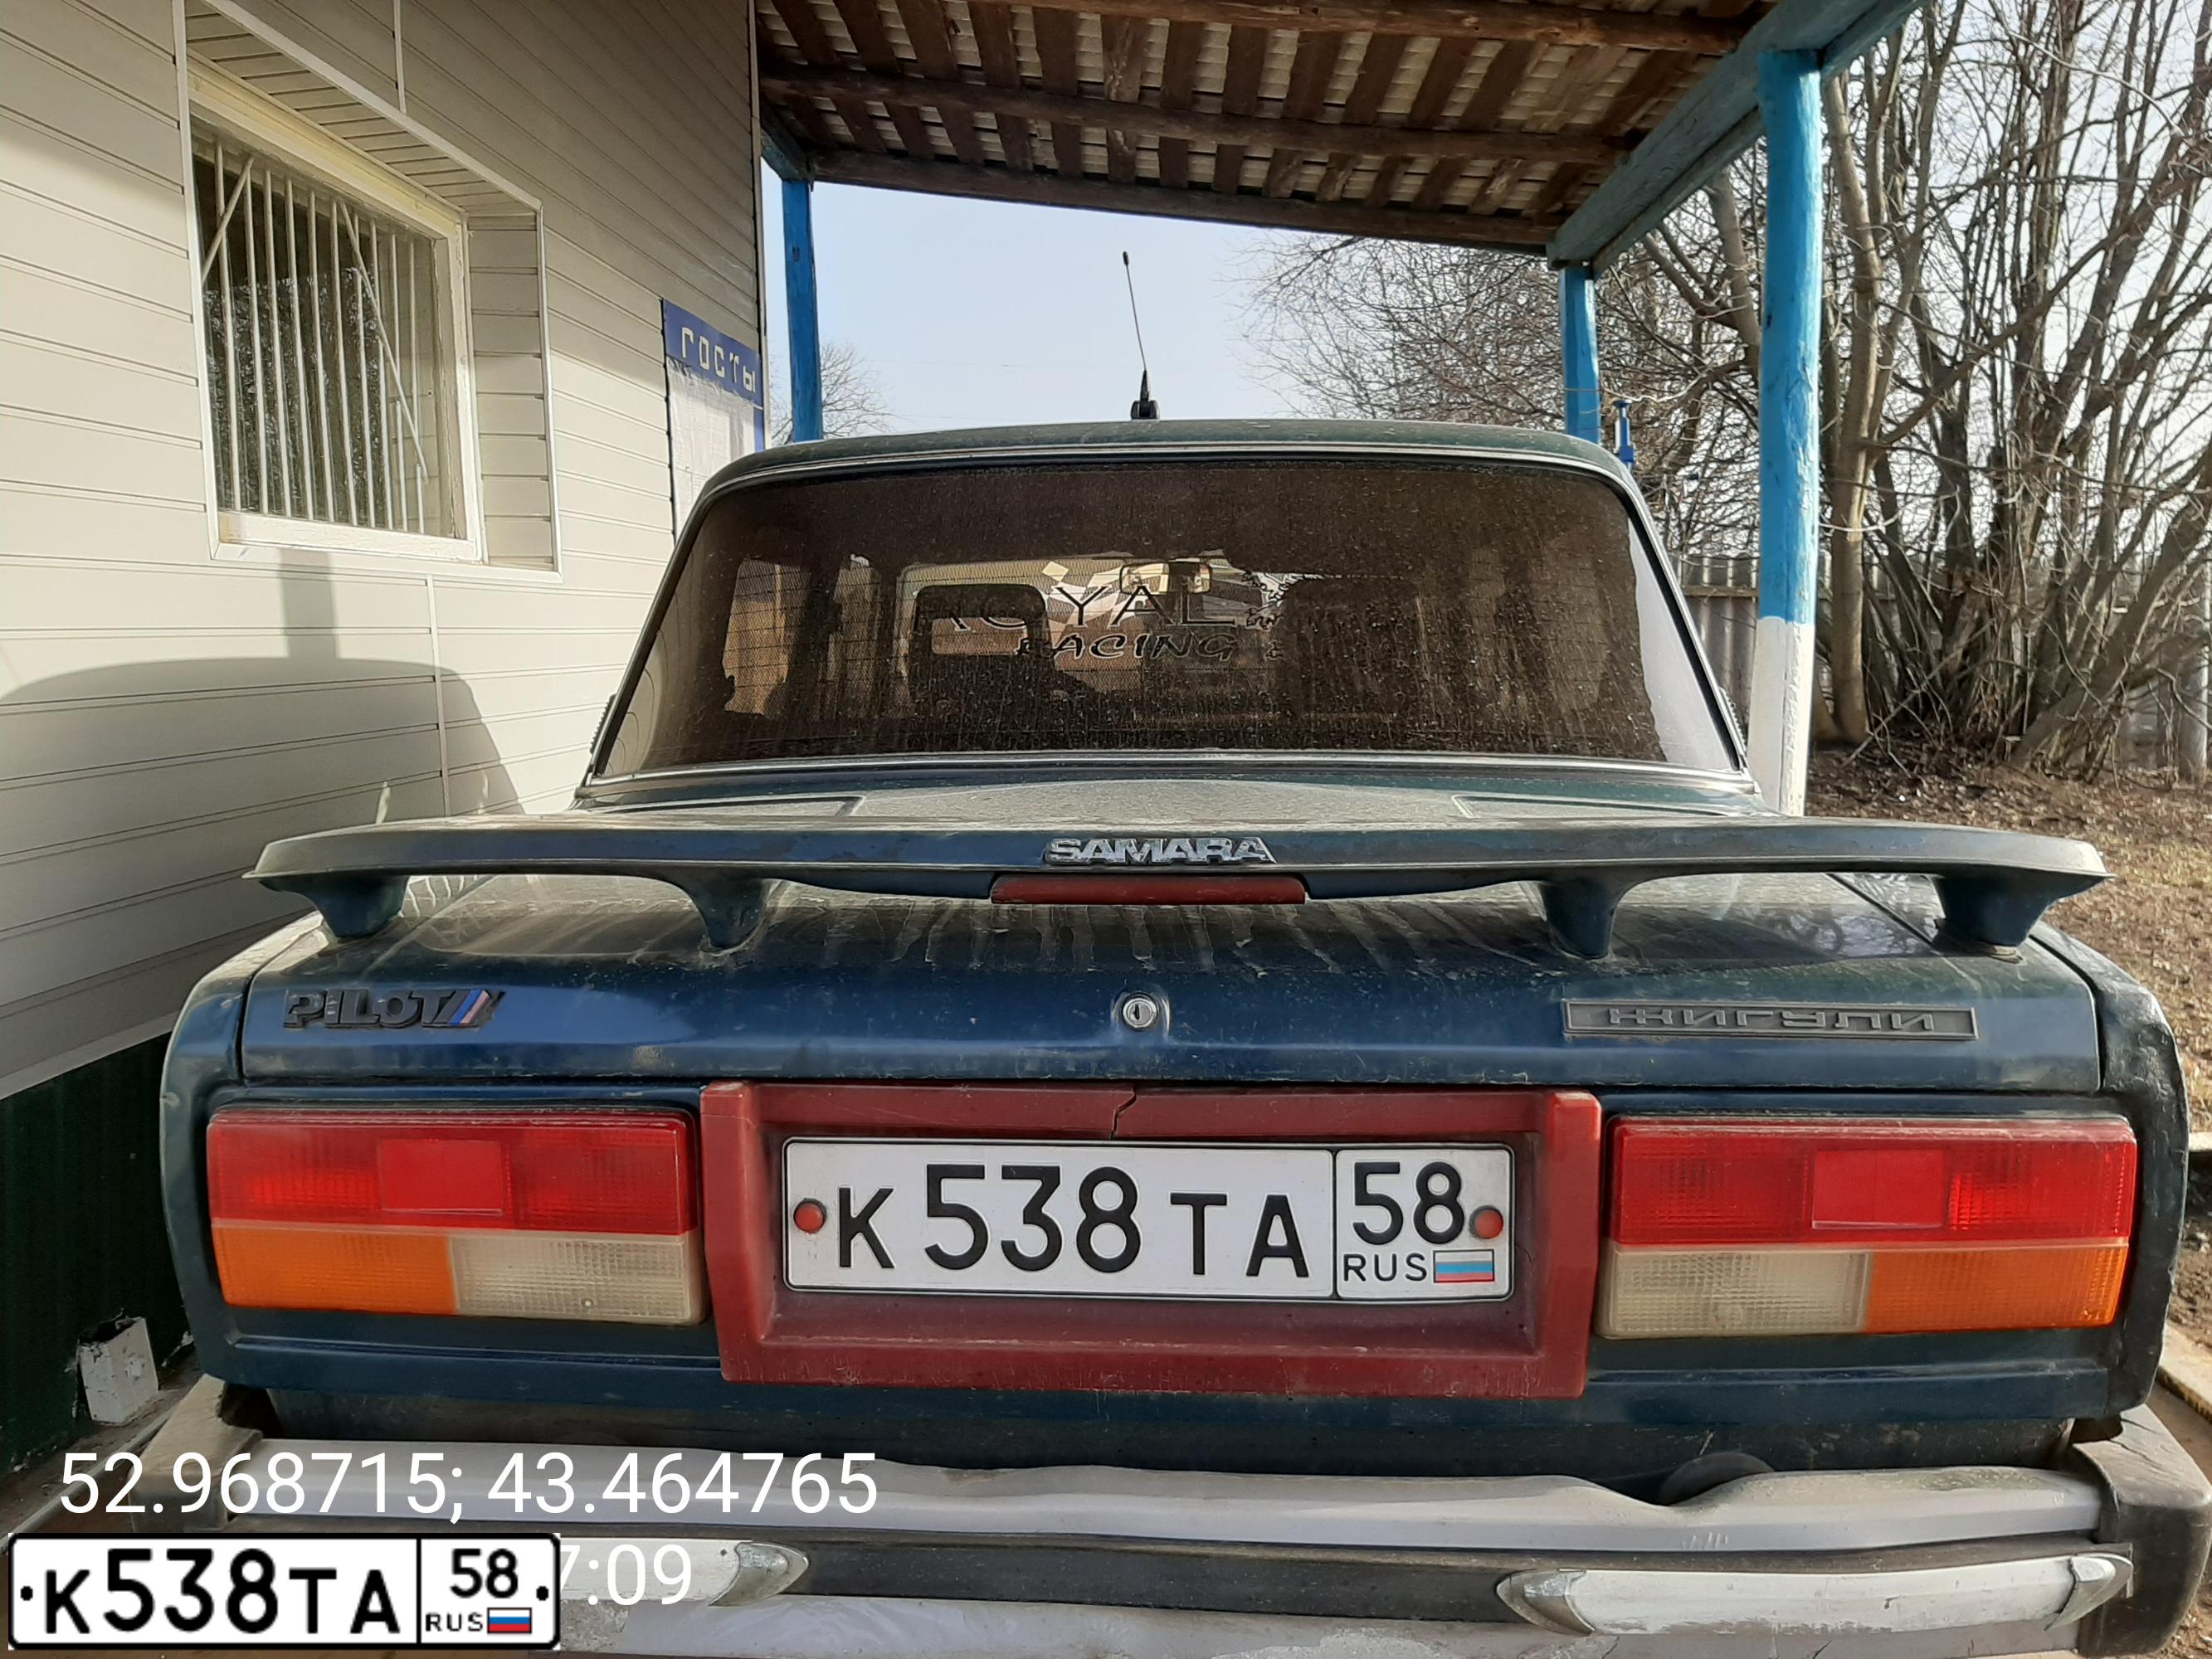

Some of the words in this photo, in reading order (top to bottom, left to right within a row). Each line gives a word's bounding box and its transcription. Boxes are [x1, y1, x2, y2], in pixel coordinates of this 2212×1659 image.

[680, 326, 757, 394] ГОСТЫ
[934, 583, 1237, 631] YAL
[1042, 835, 1279, 866] SAMARA
[282, 989, 456, 1029] PILOT
[1608, 1007, 1935, 1031] ЖИГУЛИ
[1352, 1161, 1465, 1246] 58
[1342, 1252, 1428, 1282] RUS
